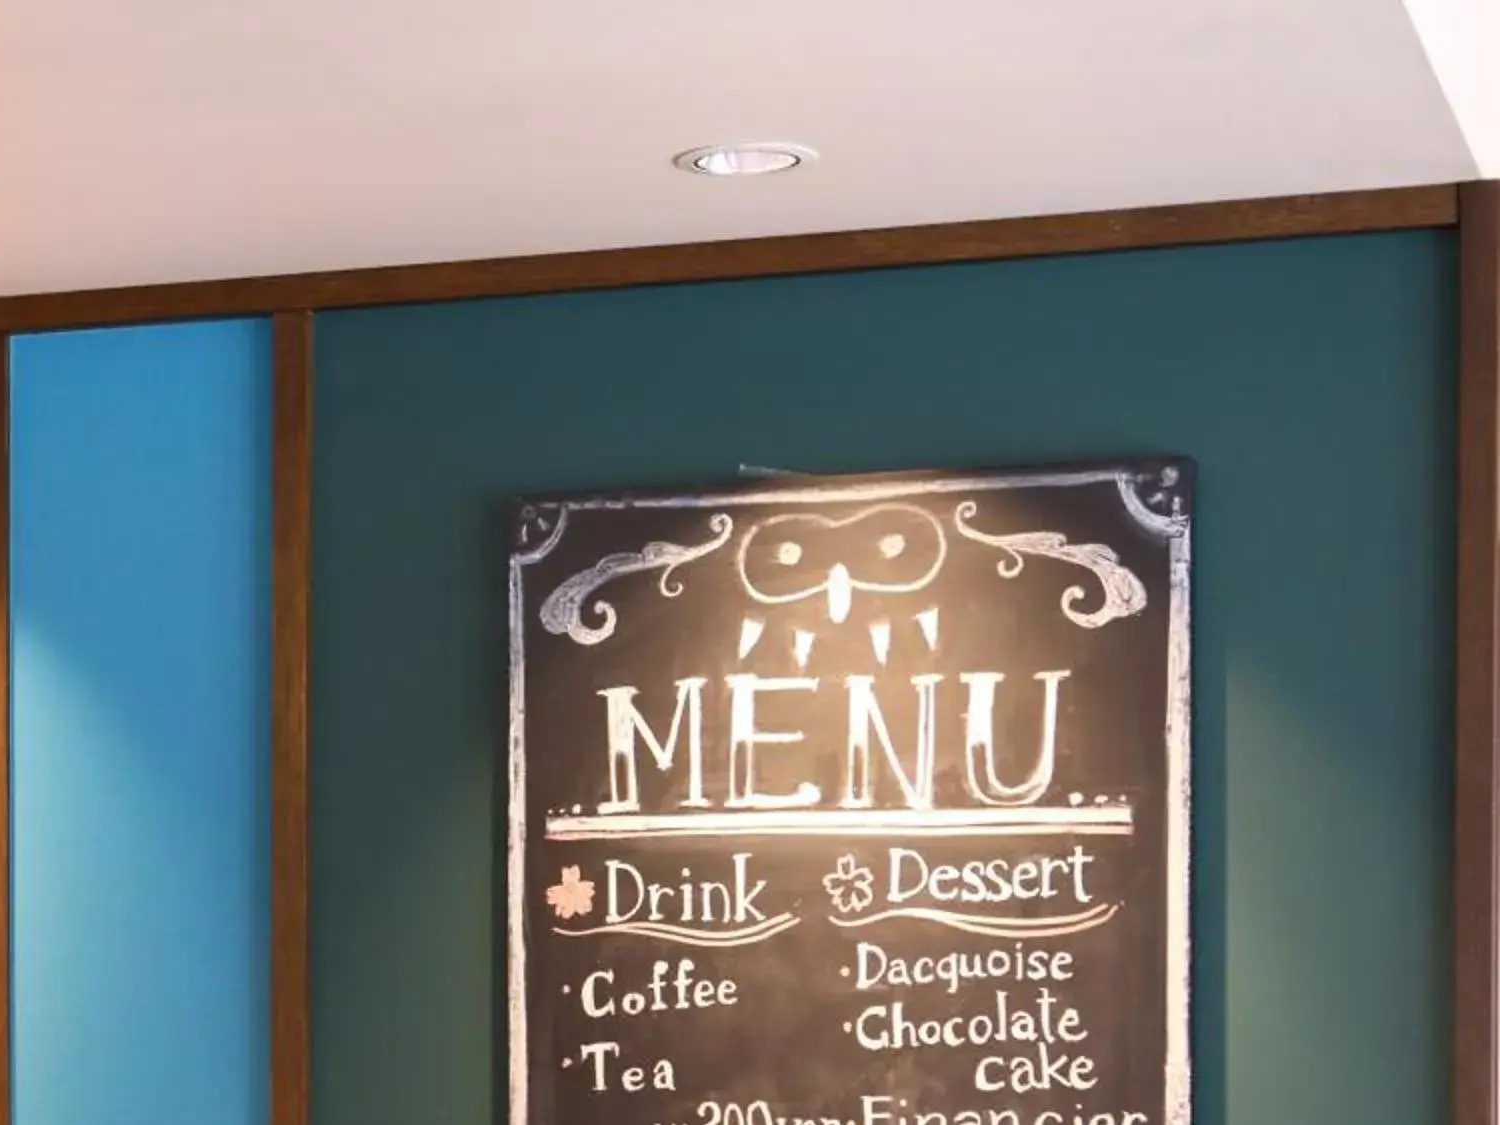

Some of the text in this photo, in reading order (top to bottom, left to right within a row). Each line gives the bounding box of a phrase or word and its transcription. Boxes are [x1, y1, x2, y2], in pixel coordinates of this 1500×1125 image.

[597, 670, 1073, 813] MENU
[605, 852, 769, 925] Drink
[886, 845, 1093, 903] Dessert
[581, 958, 738, 1018] Coffee
[855, 941, 1073, 995] Dacquoise
[856, 986, 1088, 1051] Chocolate
[580, 1041, 676, 1091] Tea
[972, 1039, 1097, 1093] cake
